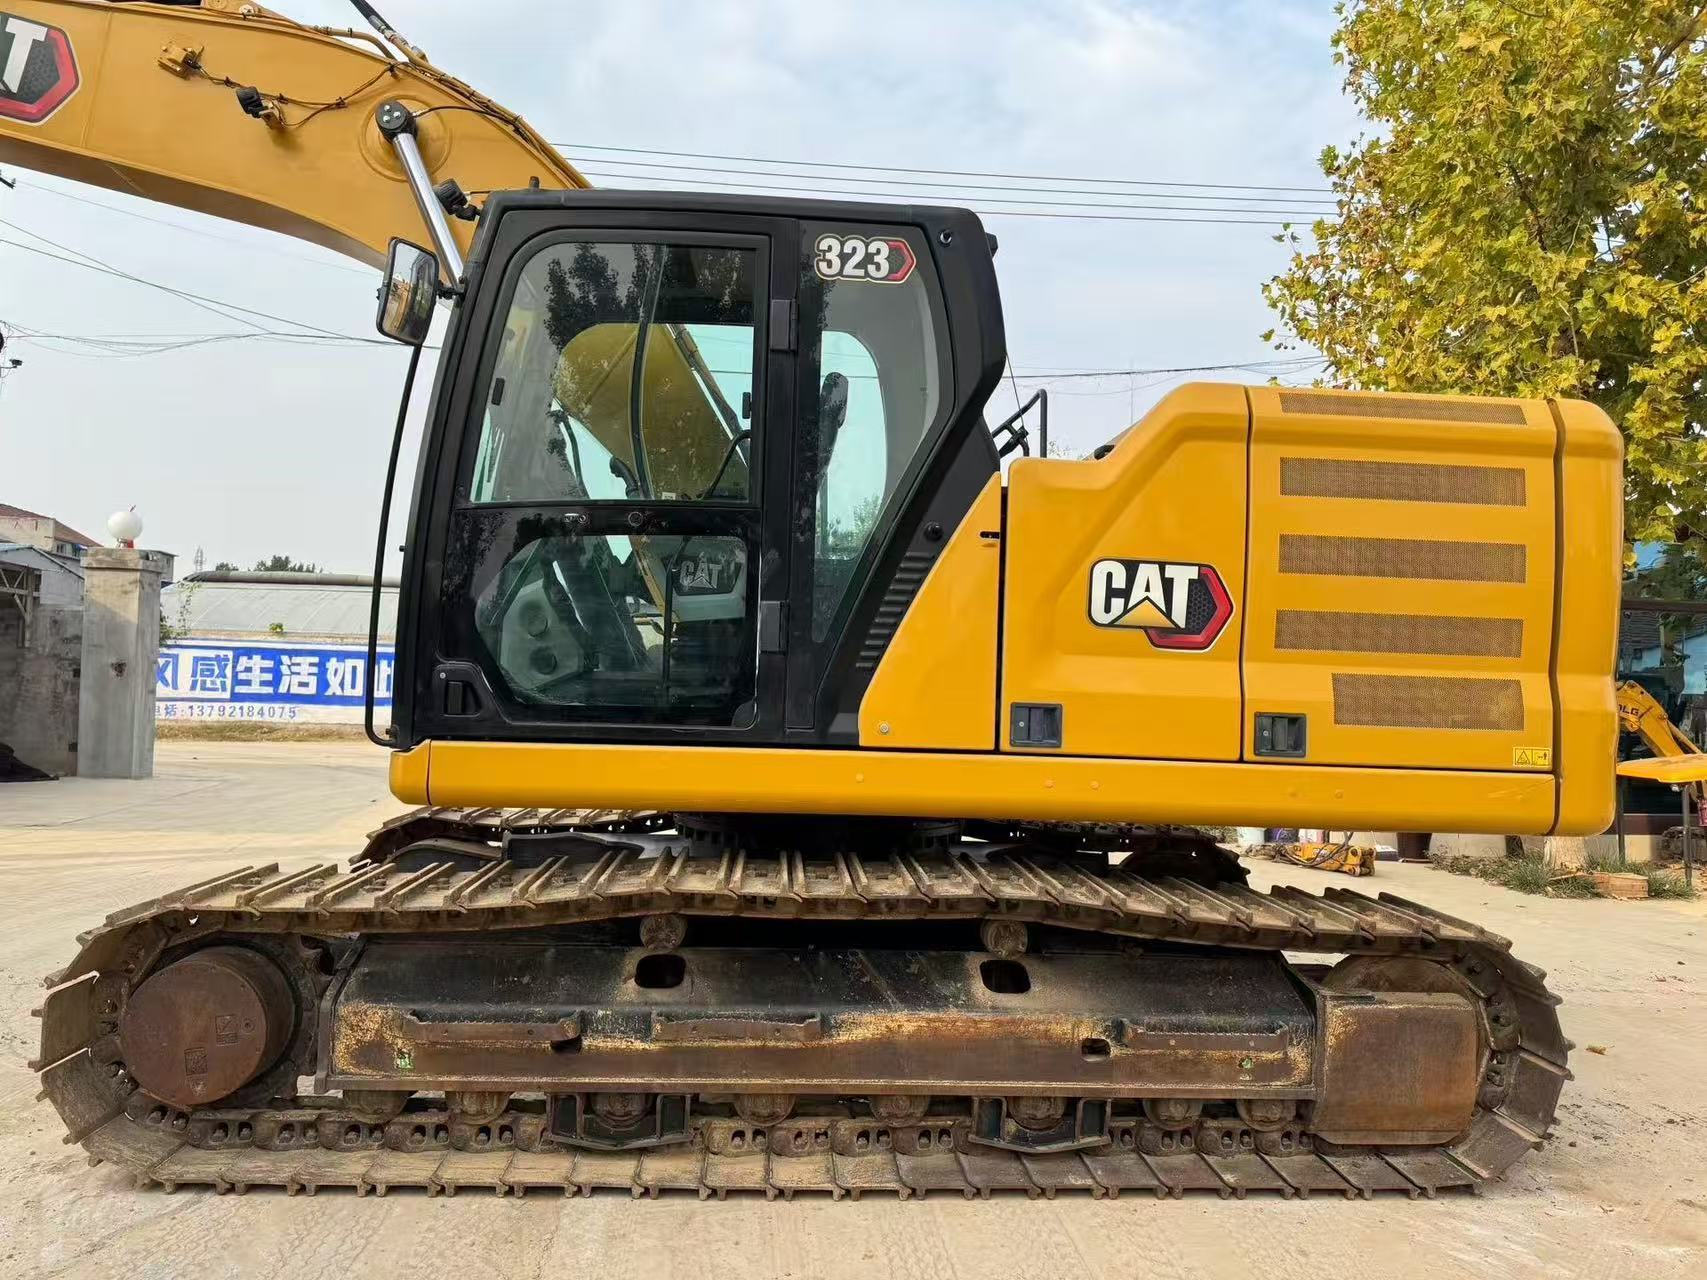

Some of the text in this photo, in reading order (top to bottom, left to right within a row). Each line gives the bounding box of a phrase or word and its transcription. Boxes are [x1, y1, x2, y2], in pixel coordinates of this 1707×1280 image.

[0, 17, 48, 94] T
[818, 237, 890, 279] 323
[680, 560, 722, 590] CAT
[1091, 560, 1199, 629] CAT
